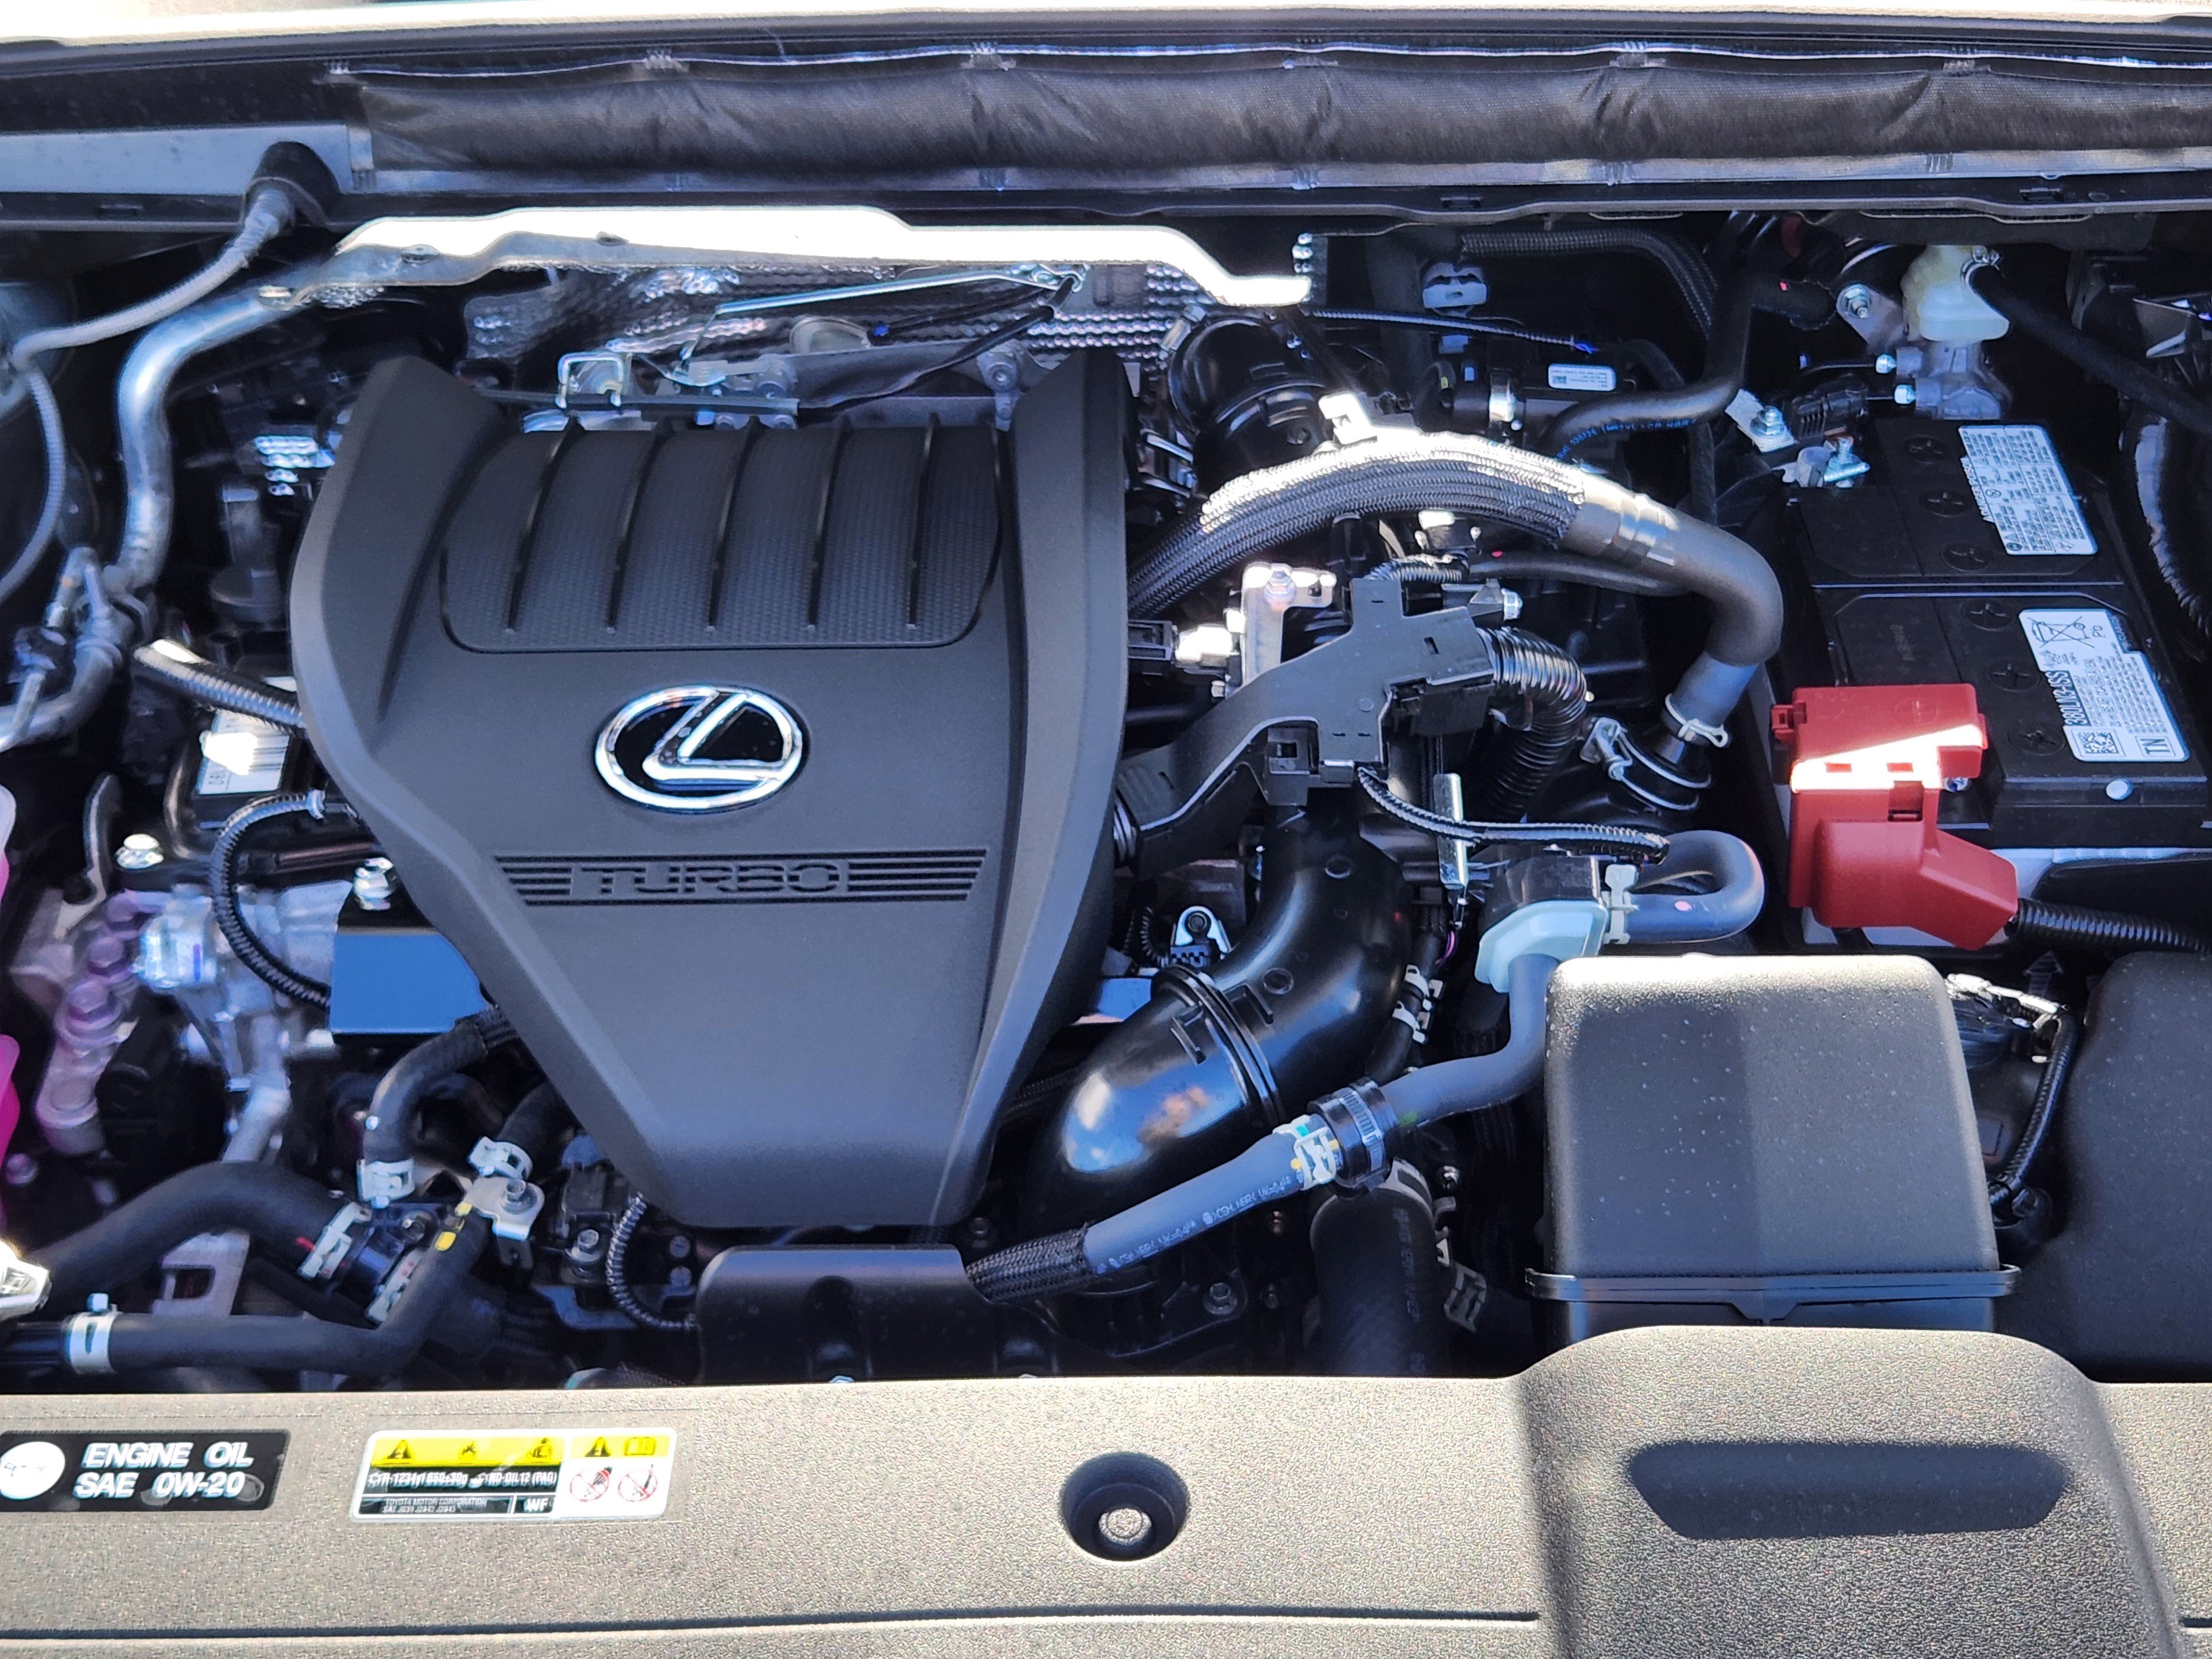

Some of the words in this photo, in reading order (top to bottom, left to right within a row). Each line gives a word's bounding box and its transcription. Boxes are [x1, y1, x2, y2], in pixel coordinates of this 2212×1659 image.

[2045, 671, 2088, 726] 380LN3-ISS
[2140, 738, 2170, 755] TN
[581, 863, 840, 894] TURBO
[82, 1442, 194, 1468] ENGINE
[204, 1442, 254, 1468] OIL
[73, 1472, 139, 1498] SAE
[153, 1471, 246, 1498] 0W-20
